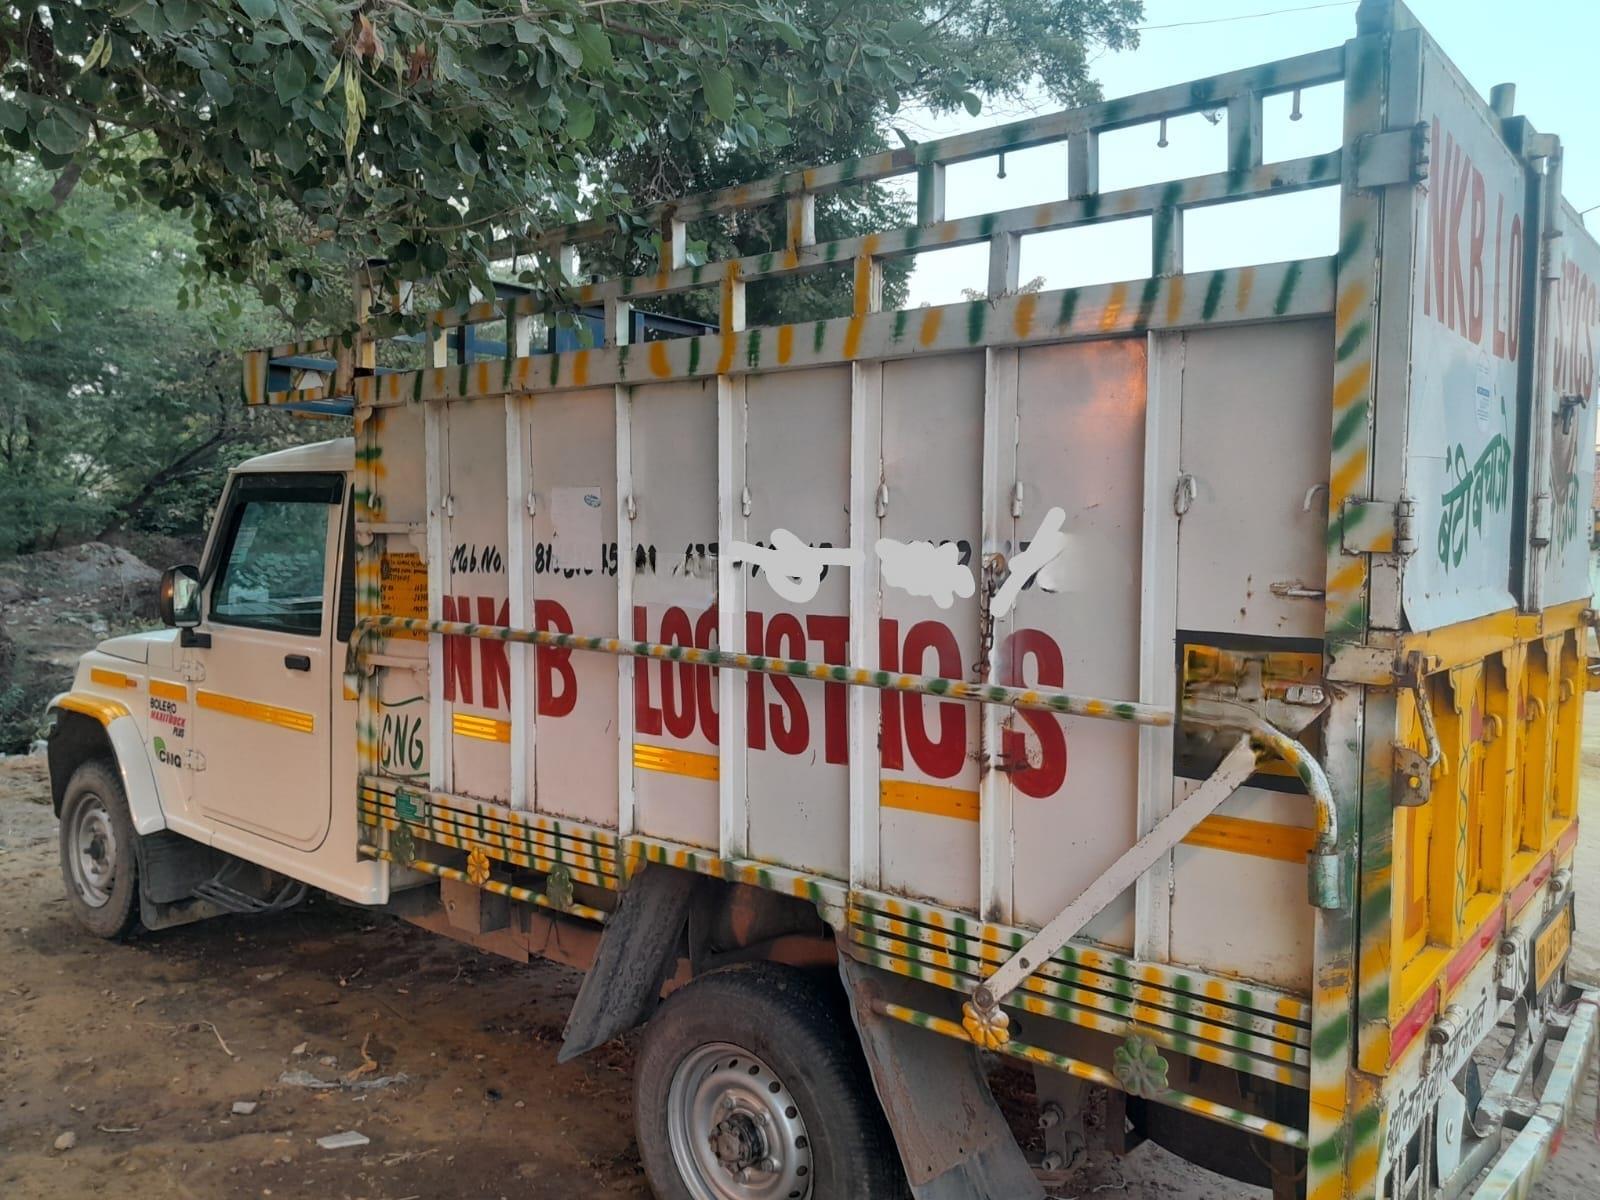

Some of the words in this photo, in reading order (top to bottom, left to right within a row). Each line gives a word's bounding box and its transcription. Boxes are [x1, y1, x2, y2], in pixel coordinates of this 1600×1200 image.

[1423, 114, 1485, 347] NKB
[1438, 443, 1474, 577] बेटी
[443, 594, 578, 718] NKB
[150, 697, 177, 714] BOLERO
[173, 727, 185, 739] PLUS
[381, 713, 424, 770] CNG
